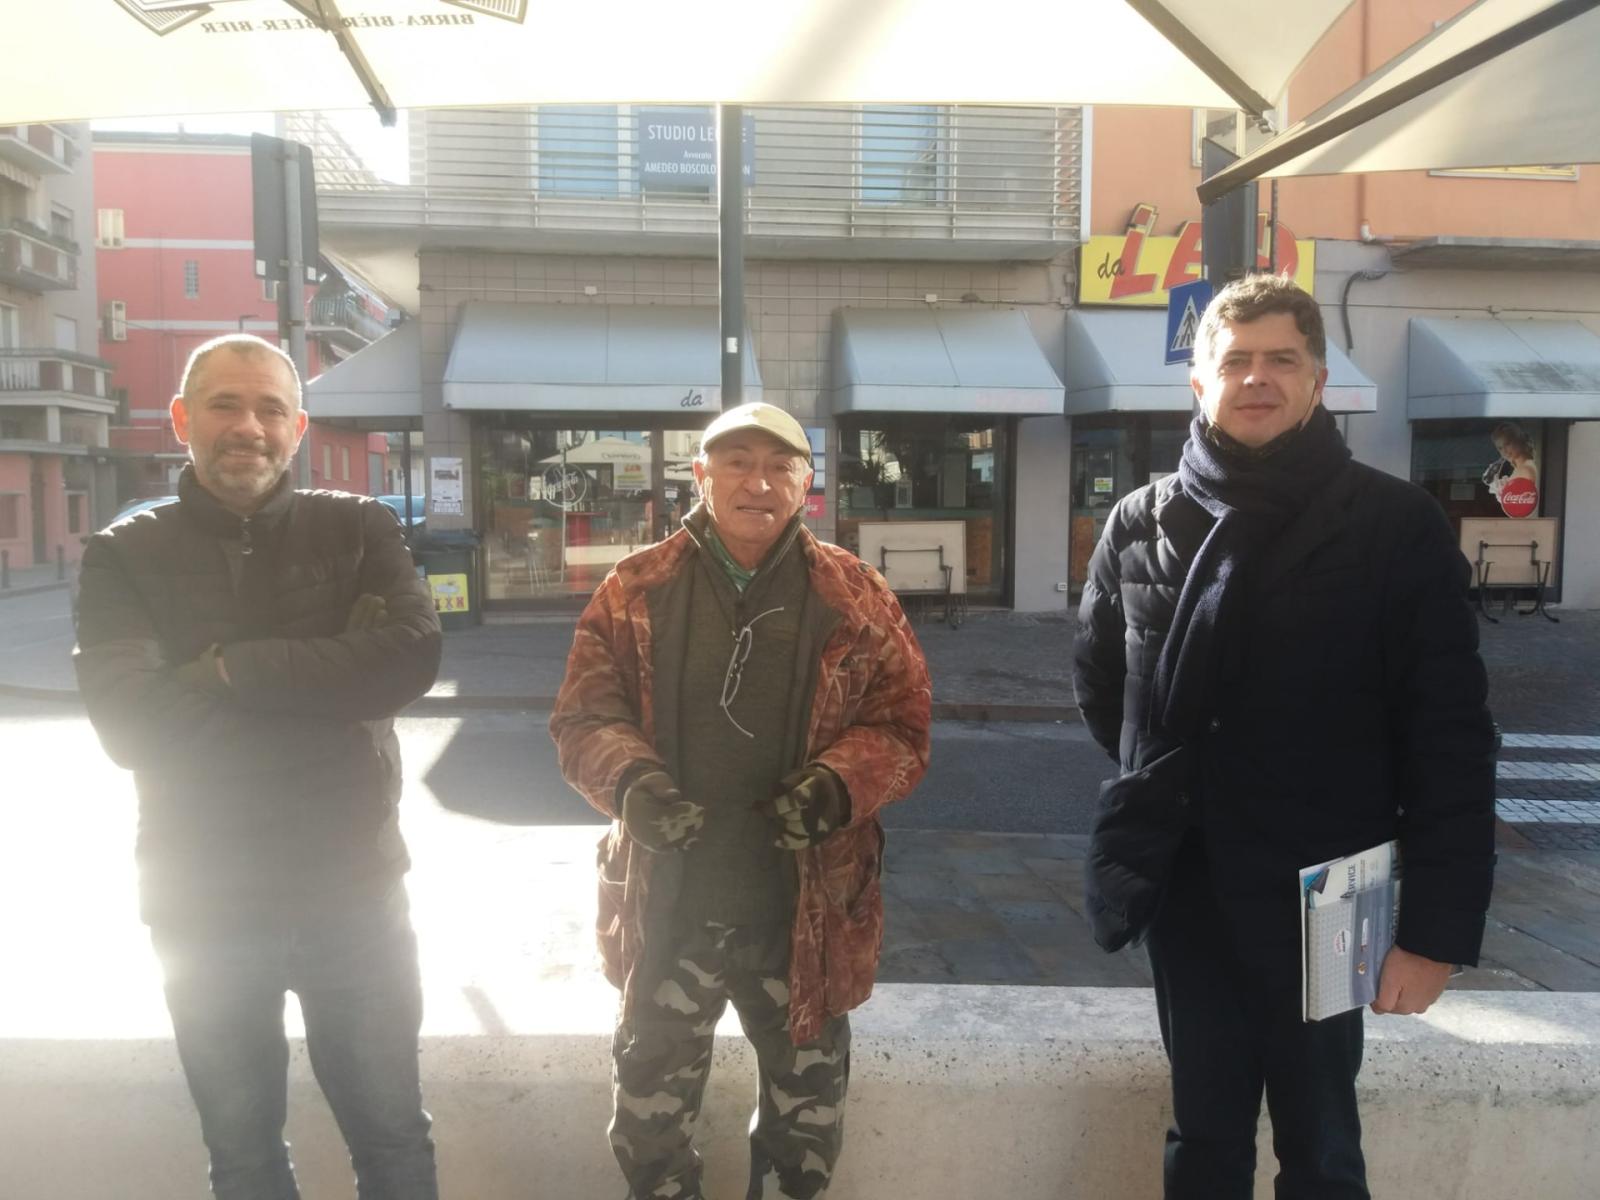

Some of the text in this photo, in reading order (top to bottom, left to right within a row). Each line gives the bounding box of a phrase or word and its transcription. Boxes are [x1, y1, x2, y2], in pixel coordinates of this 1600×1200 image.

[648, 124, 696, 142] STUDIO
[645, 162, 717, 175] AMEDEO BOSCOLO
[1097, 252, 1126, 280] da
[680, 388, 705, 407] da
